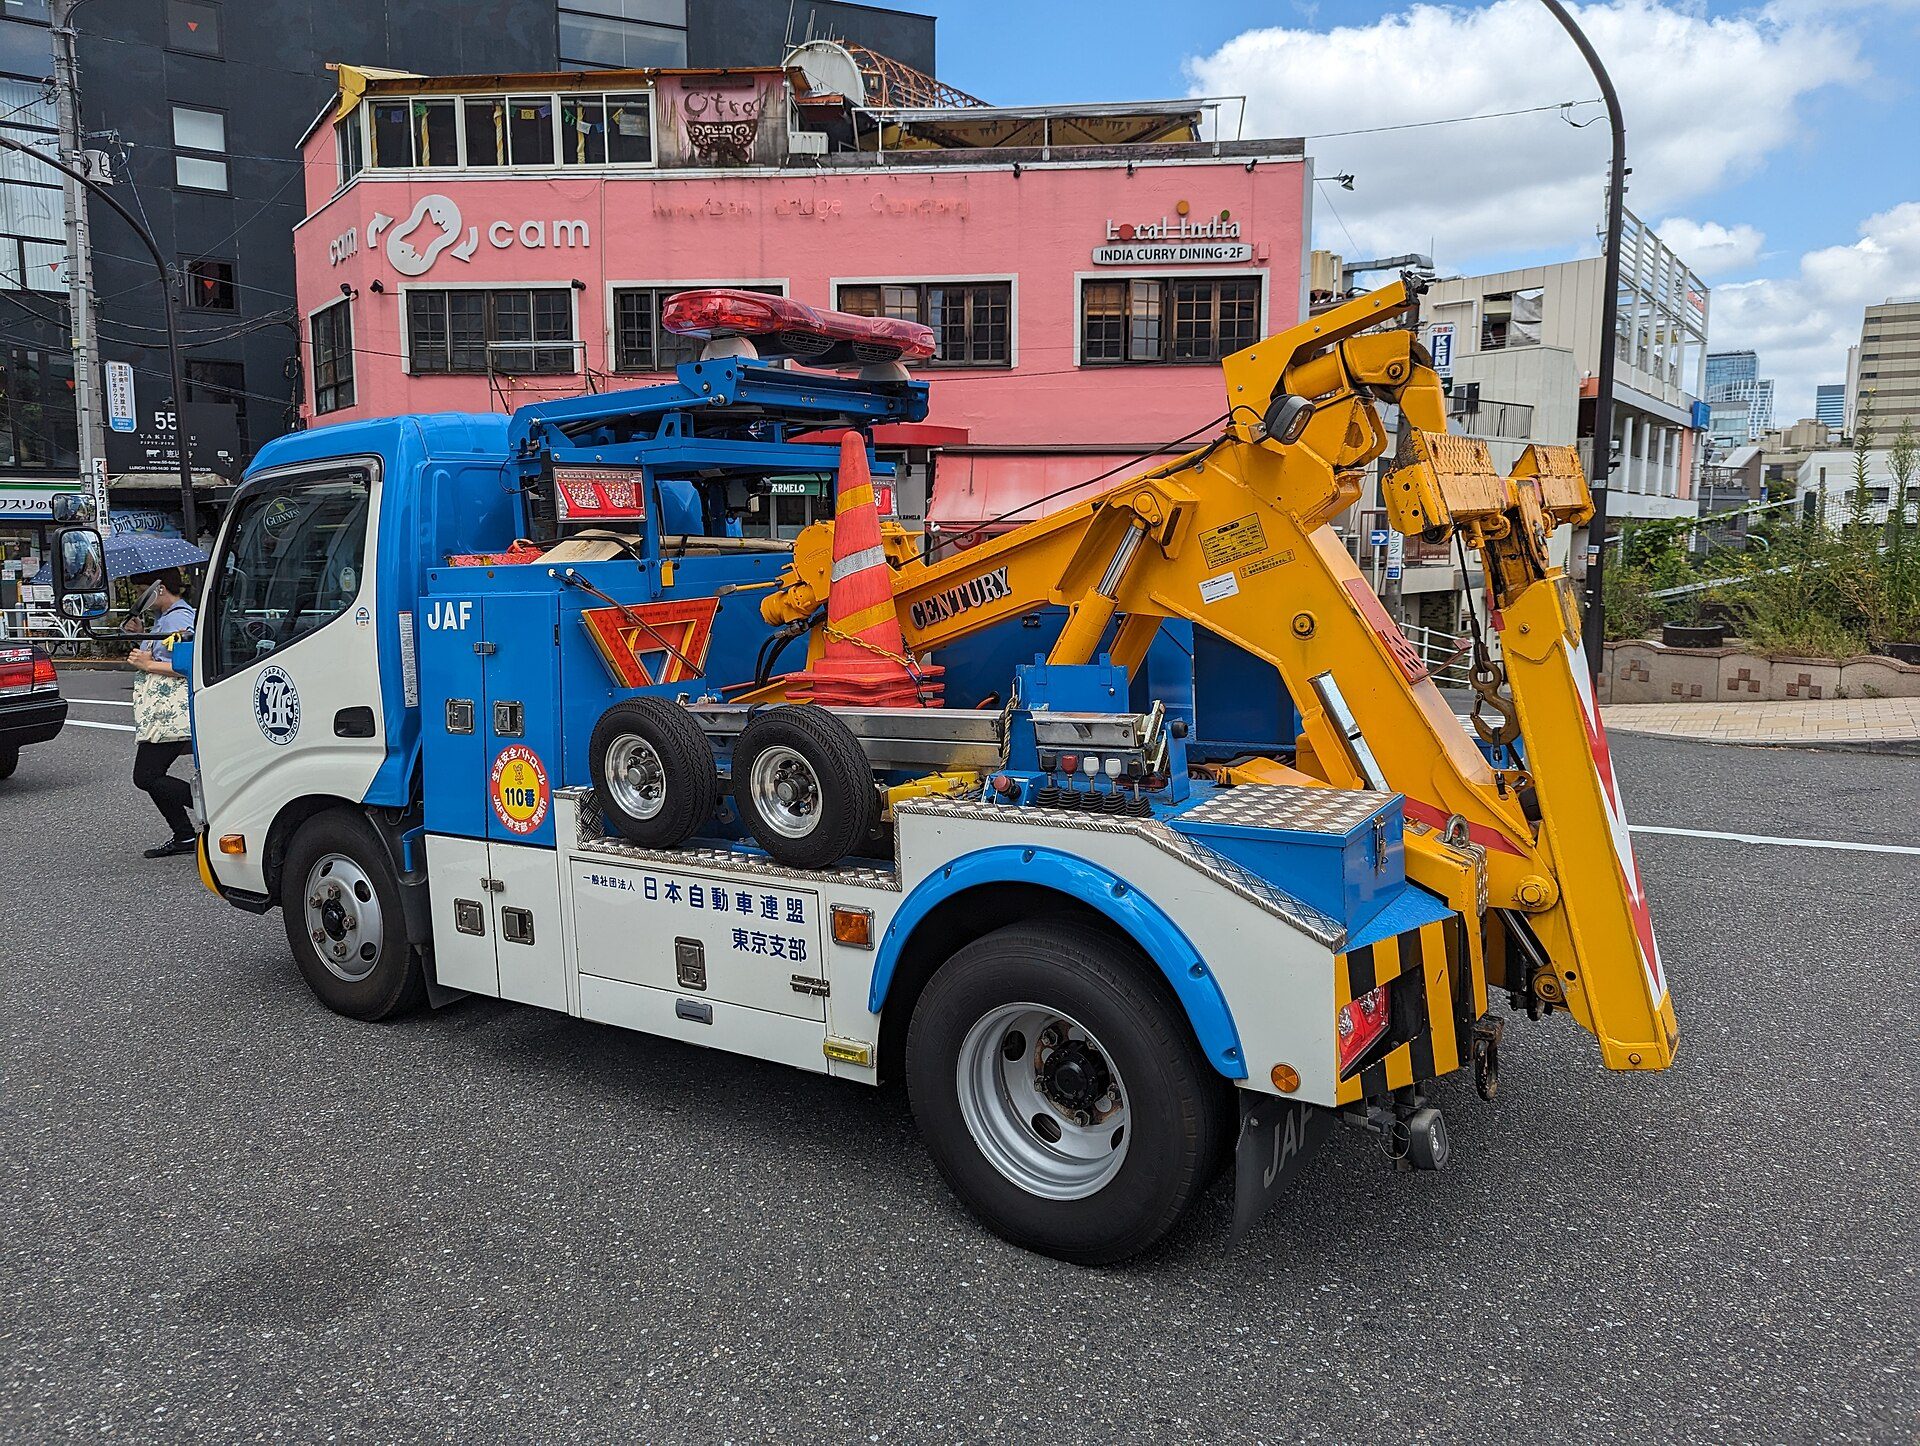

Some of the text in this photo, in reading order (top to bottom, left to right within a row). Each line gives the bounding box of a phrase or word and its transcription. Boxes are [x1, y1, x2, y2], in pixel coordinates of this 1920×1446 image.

[684, 91, 767, 117] Otra
[1106, 211, 1241, 242] Local India
[329, 219, 591, 267] cam cam
[1100, 249, 1134, 261] INDIA
[1137, 248, 1177, 260] CURRY
[1434, 335, 1448, 366] KEN
[154, 411, 177, 430] 55
[771, 483, 806, 493] ARMELO
[0, 499, 54, 510] クスリの
[910, 565, 1012, 630] CENTURY
[427, 601, 473, 630] JAF
[264, 667, 286, 679] JAPAN
[283, 687, 299, 742] AUTOMOBILE
[491, 747, 546, 785] 生活安全パトロール
[505, 787, 536, 808] 110番
[583, 874, 805, 924] 一般社団法人 日本自動車連盟
[731, 928, 807, 962] 東京支部
